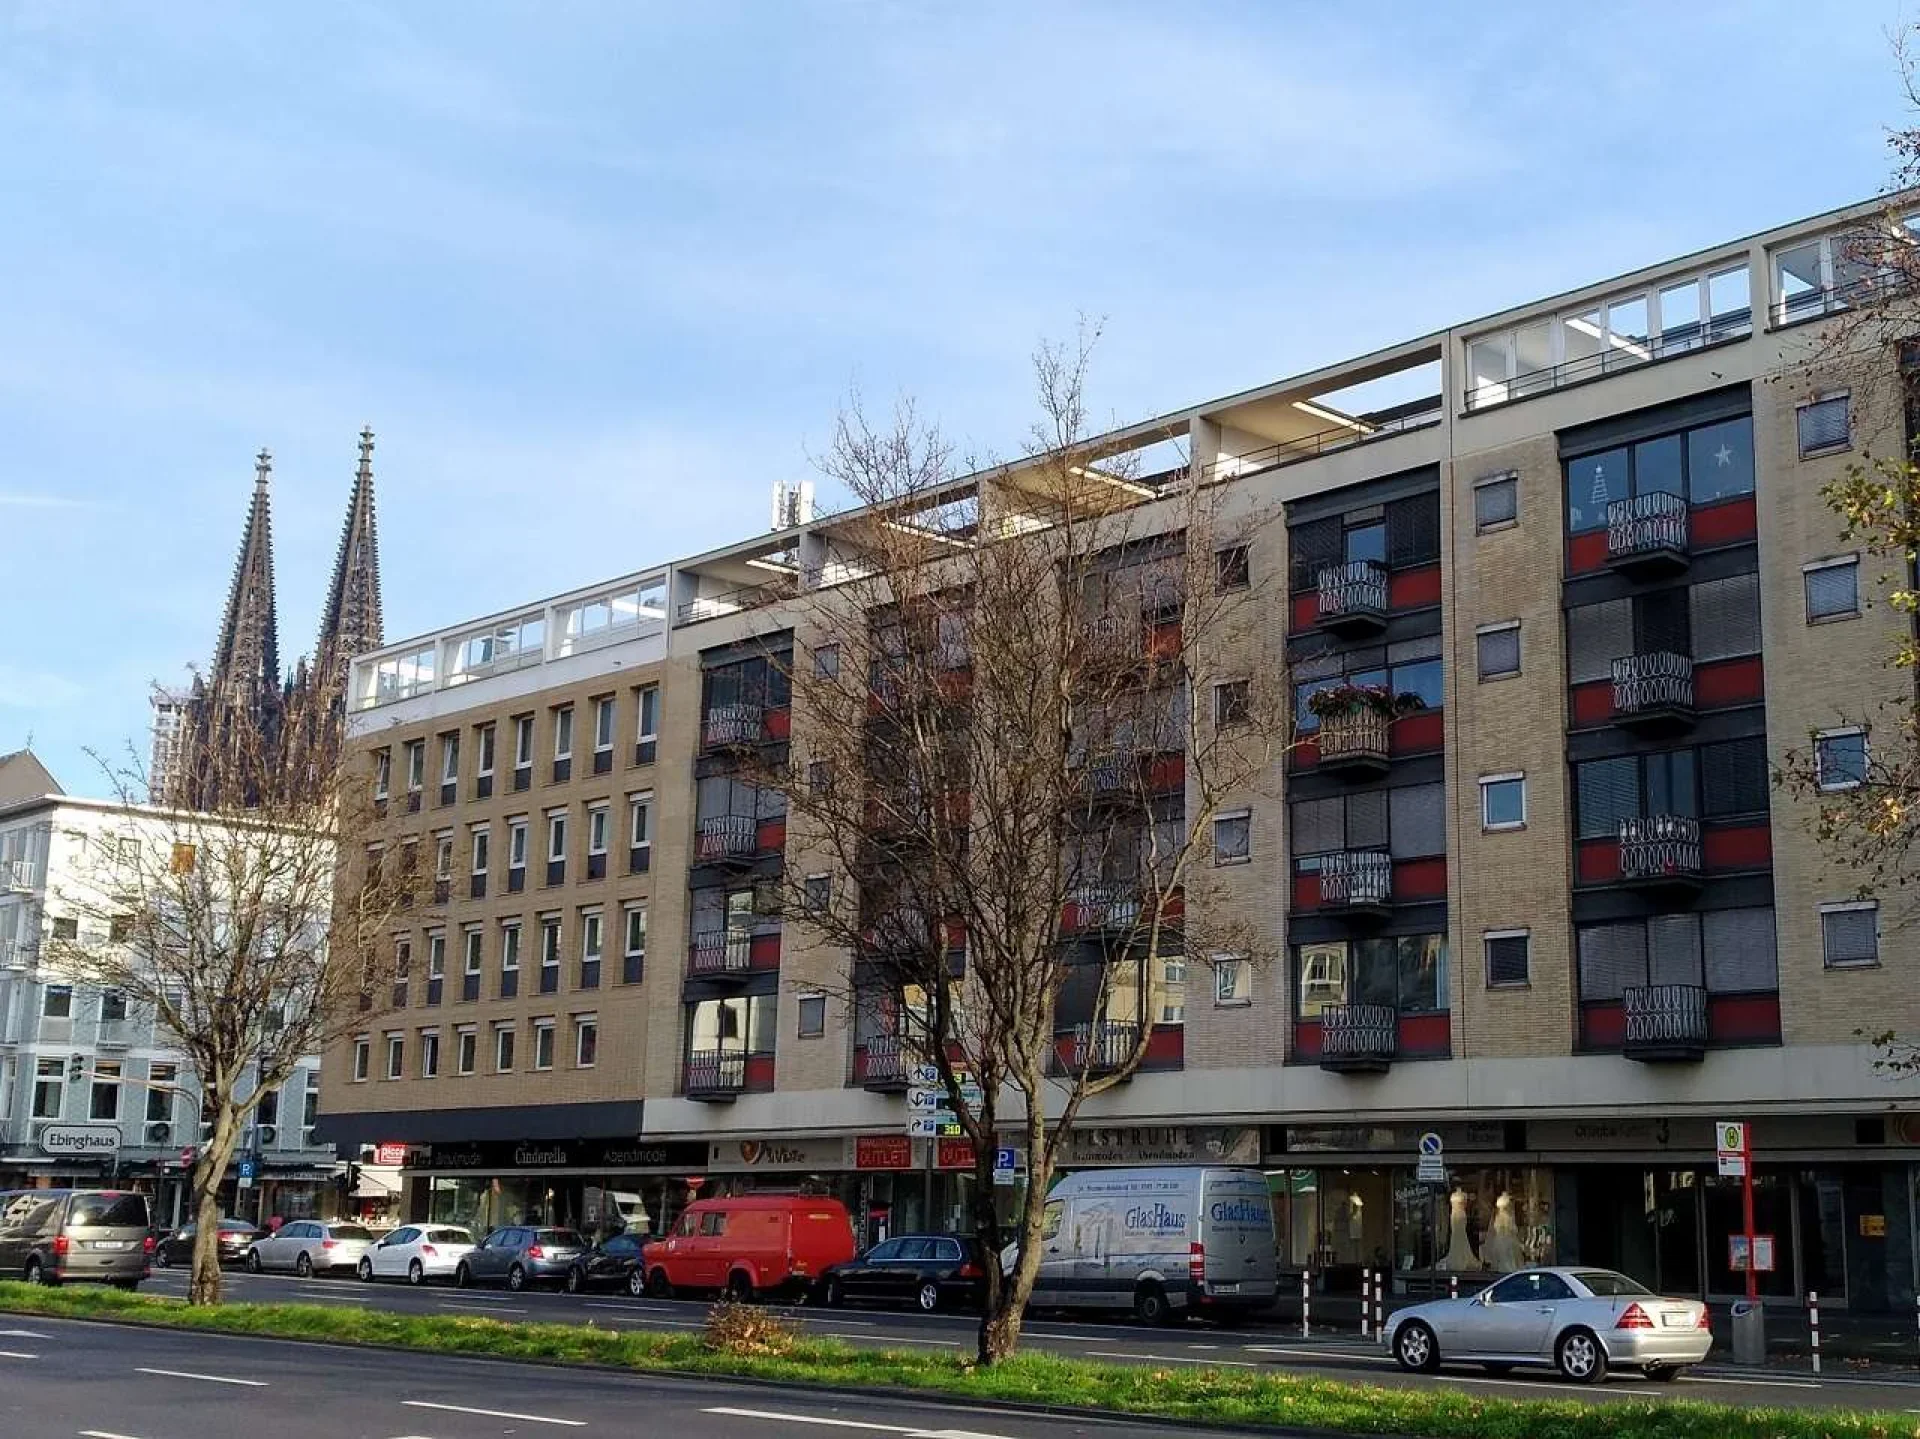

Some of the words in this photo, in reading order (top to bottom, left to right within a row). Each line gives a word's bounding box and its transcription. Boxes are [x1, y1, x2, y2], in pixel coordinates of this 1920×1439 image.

[944, 1125, 961, 1136] 310
[49, 1133, 115, 1150] Ebinghaus
[515, 1145, 567, 1165] Cinderella
[860, 1150, 908, 1166] OUTLET
[998, 1151, 1009, 1168] P
[1125, 1202, 1186, 1229] GlasHaus
[1211, 1199, 1269, 1223] GlasHaus
